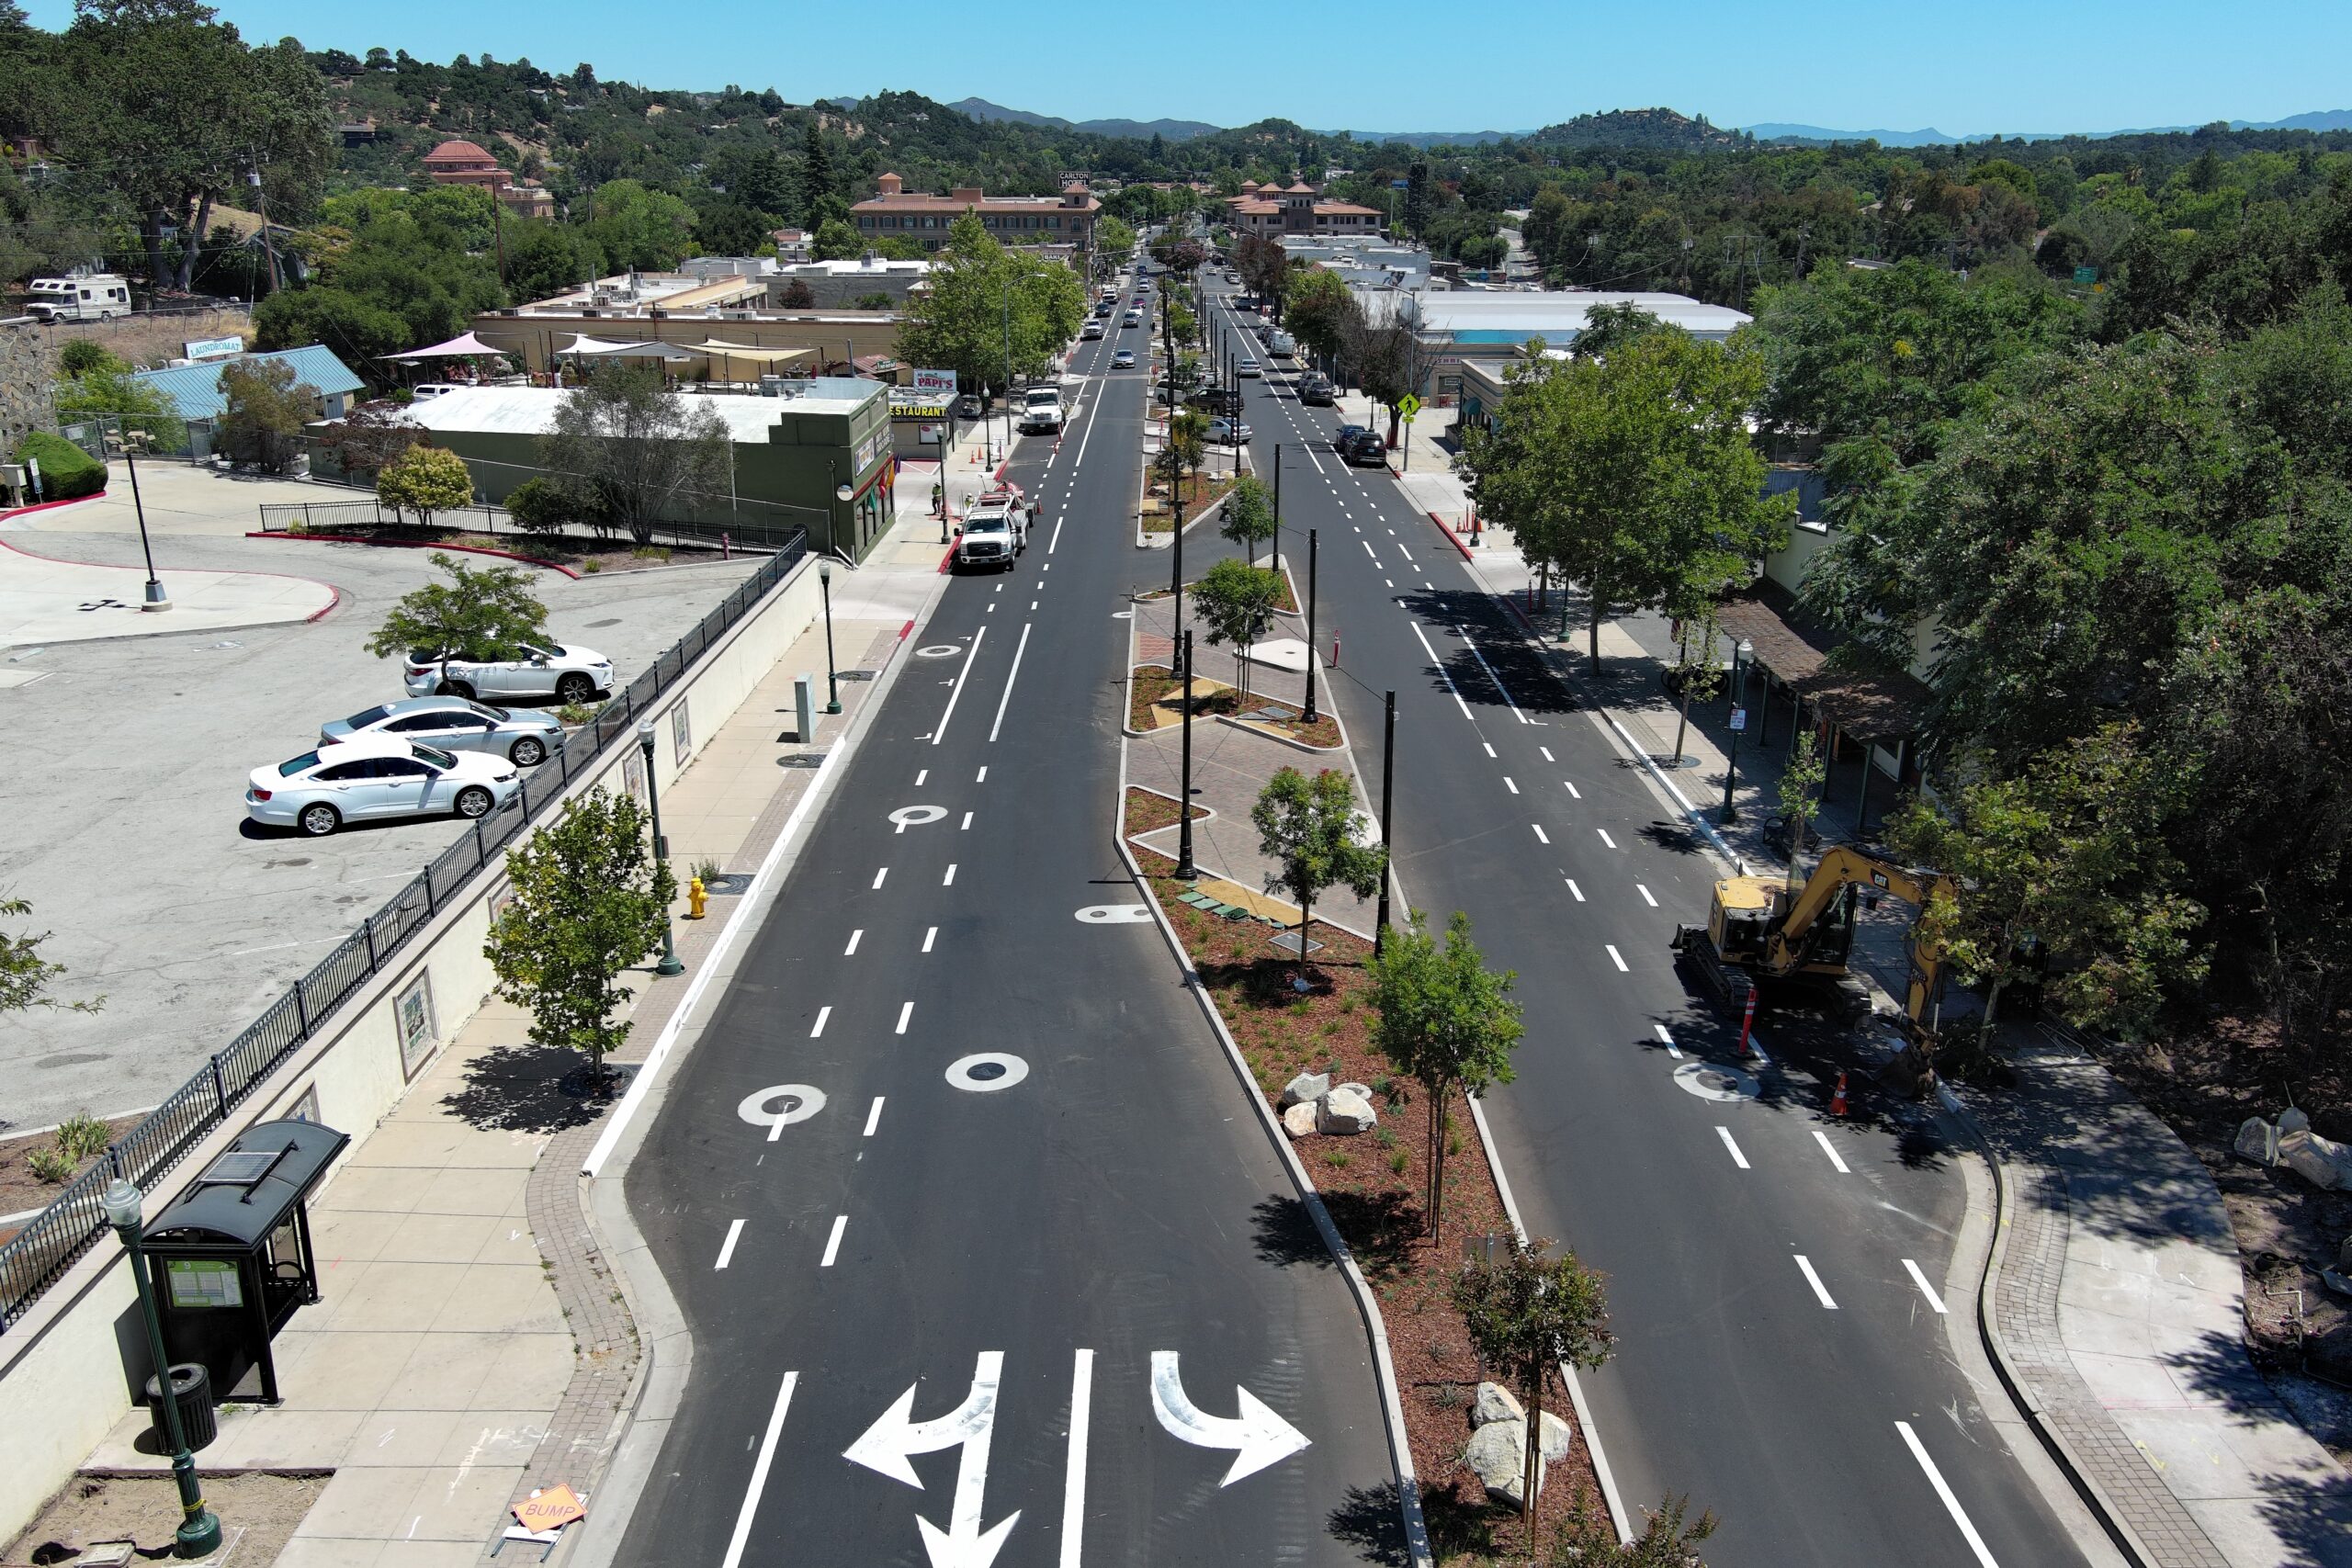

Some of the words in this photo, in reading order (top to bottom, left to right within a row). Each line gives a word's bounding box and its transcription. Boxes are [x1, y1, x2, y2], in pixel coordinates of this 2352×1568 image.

[190, 343, 240, 357] LAUNDROMAT
[919, 378, 954, 389] PAPI'S
[889, 406, 946, 417] ESTAURANT
[1874, 874, 1887, 887] CAT
[526, 1504, 575, 1517] BUMP
